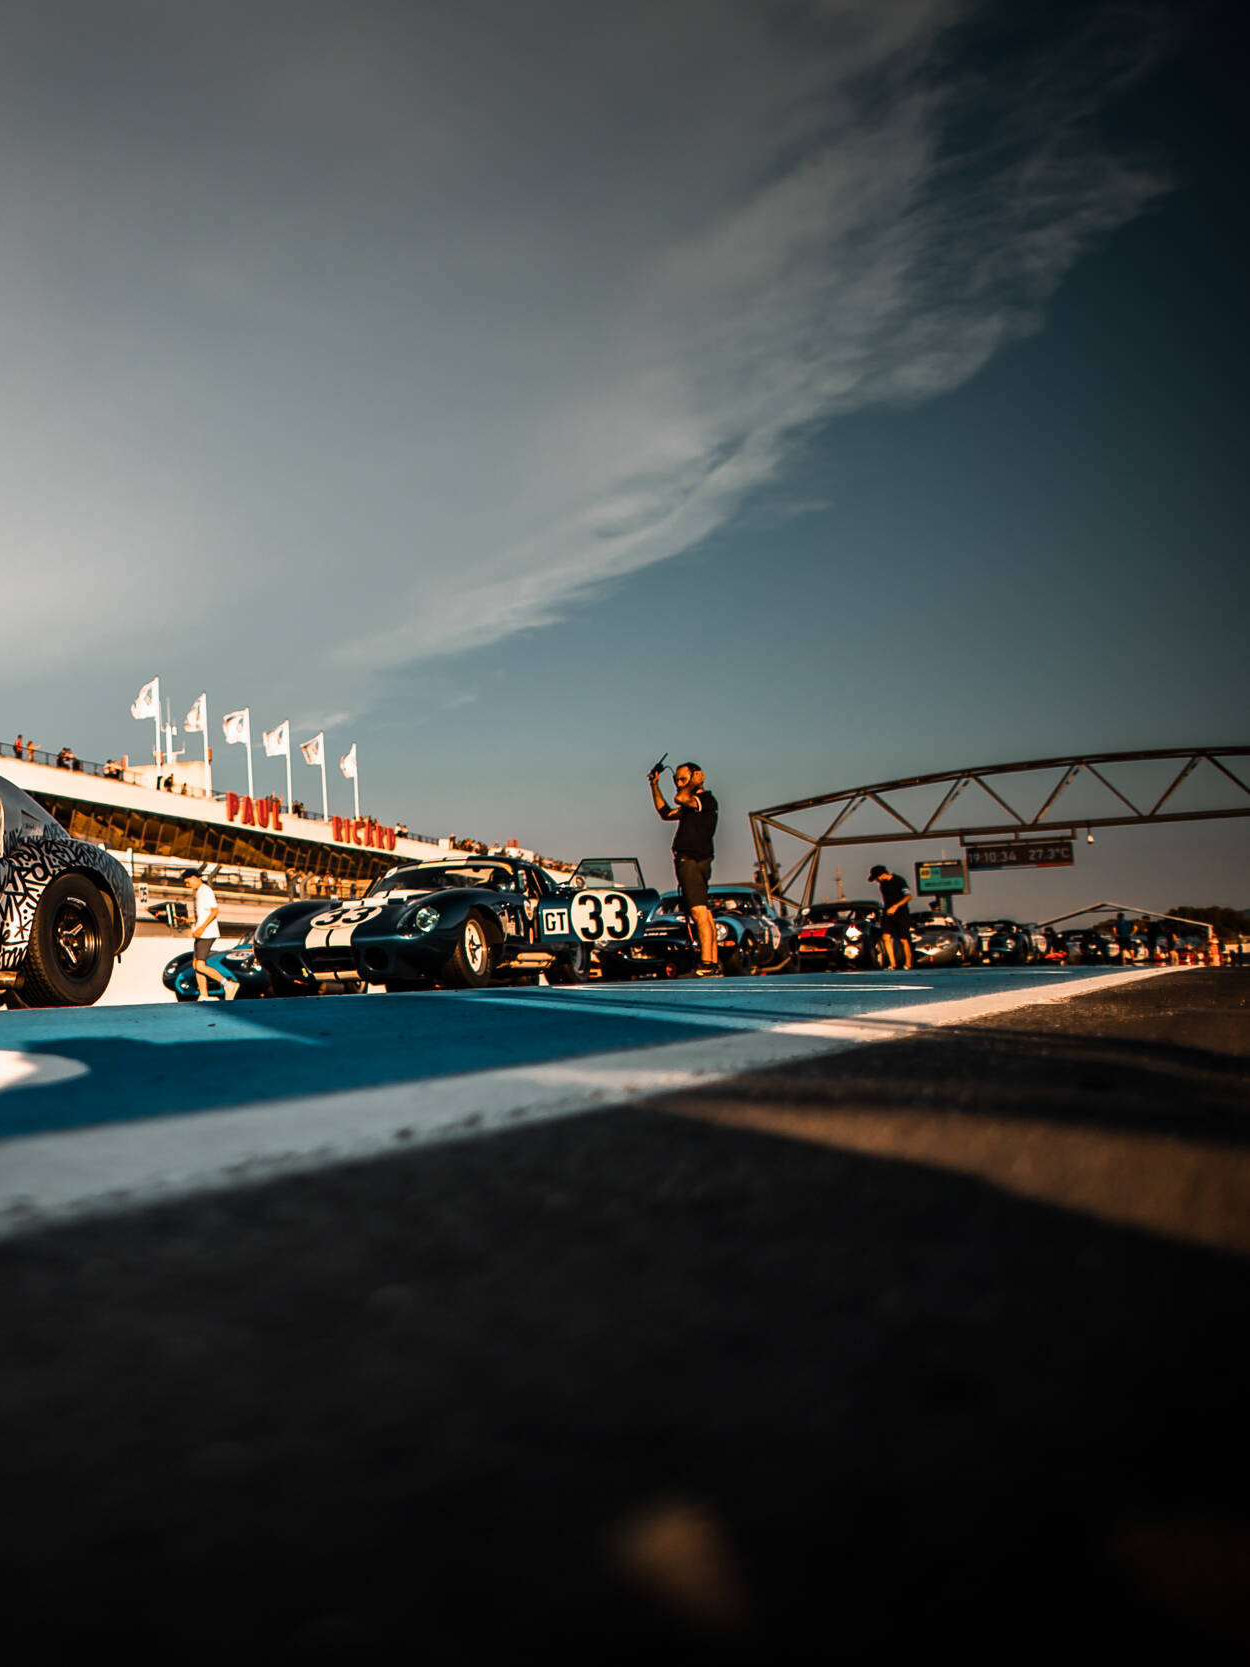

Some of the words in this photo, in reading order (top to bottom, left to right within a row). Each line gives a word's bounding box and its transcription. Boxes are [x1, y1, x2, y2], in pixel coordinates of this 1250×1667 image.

[225, 791, 283, 831] PAUL
[332, 814, 397, 851] RICARD
[316, 906, 372, 925] 33
[545, 912, 566, 931] GT
[578, 894, 630, 940] 33
